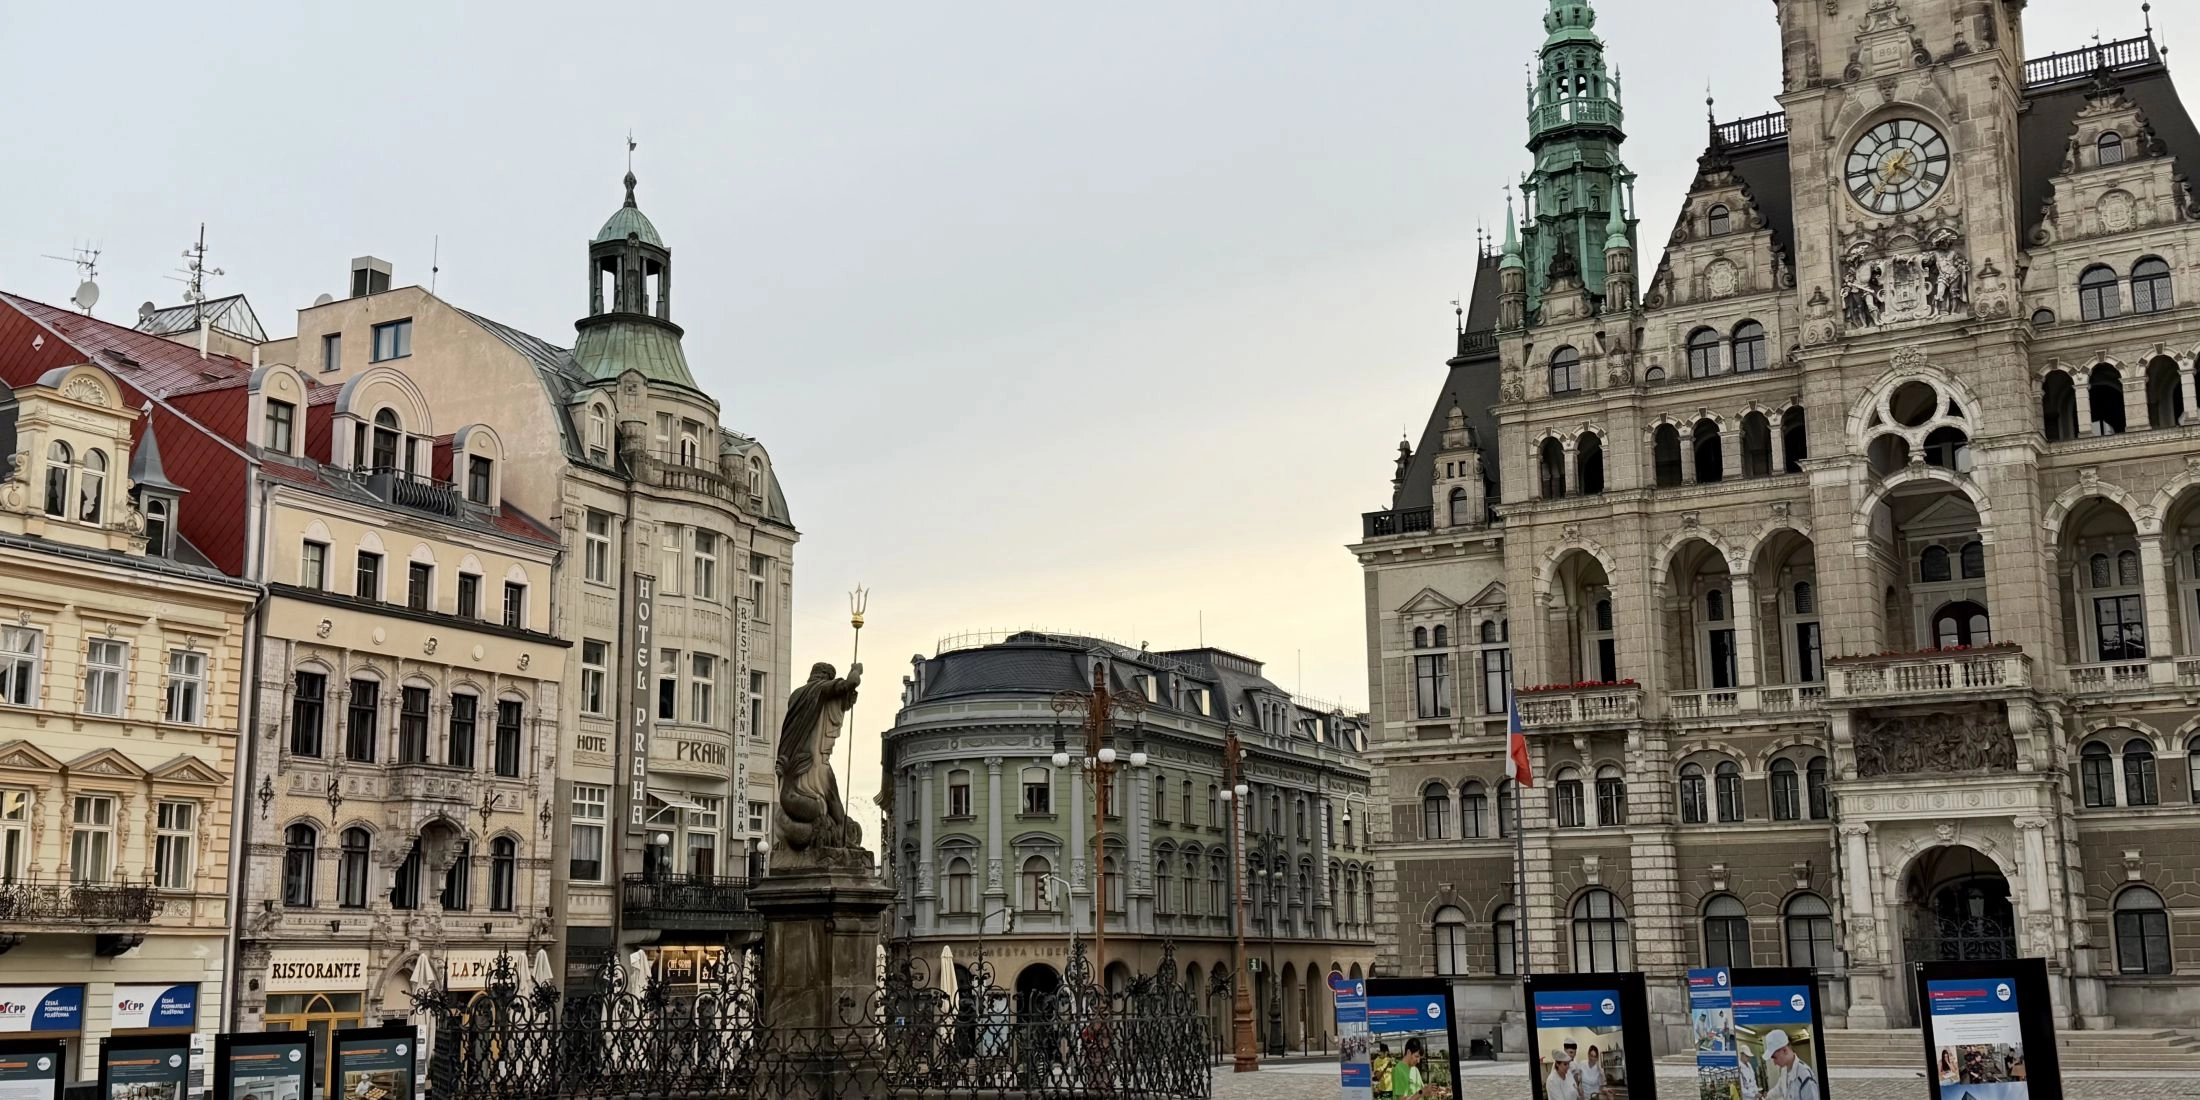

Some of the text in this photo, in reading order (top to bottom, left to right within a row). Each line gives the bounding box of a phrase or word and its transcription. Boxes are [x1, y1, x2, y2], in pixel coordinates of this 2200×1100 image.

[739, 607, 747, 746] RESTAURANT
[631, 578, 650, 826] HOTEL PRAHA
[676, 740, 726, 767] PRAHA
[737, 763, 745, 833] PRAHA
[272, 963, 361, 979] RISTORANTE
[451, 962, 469, 977] LA
